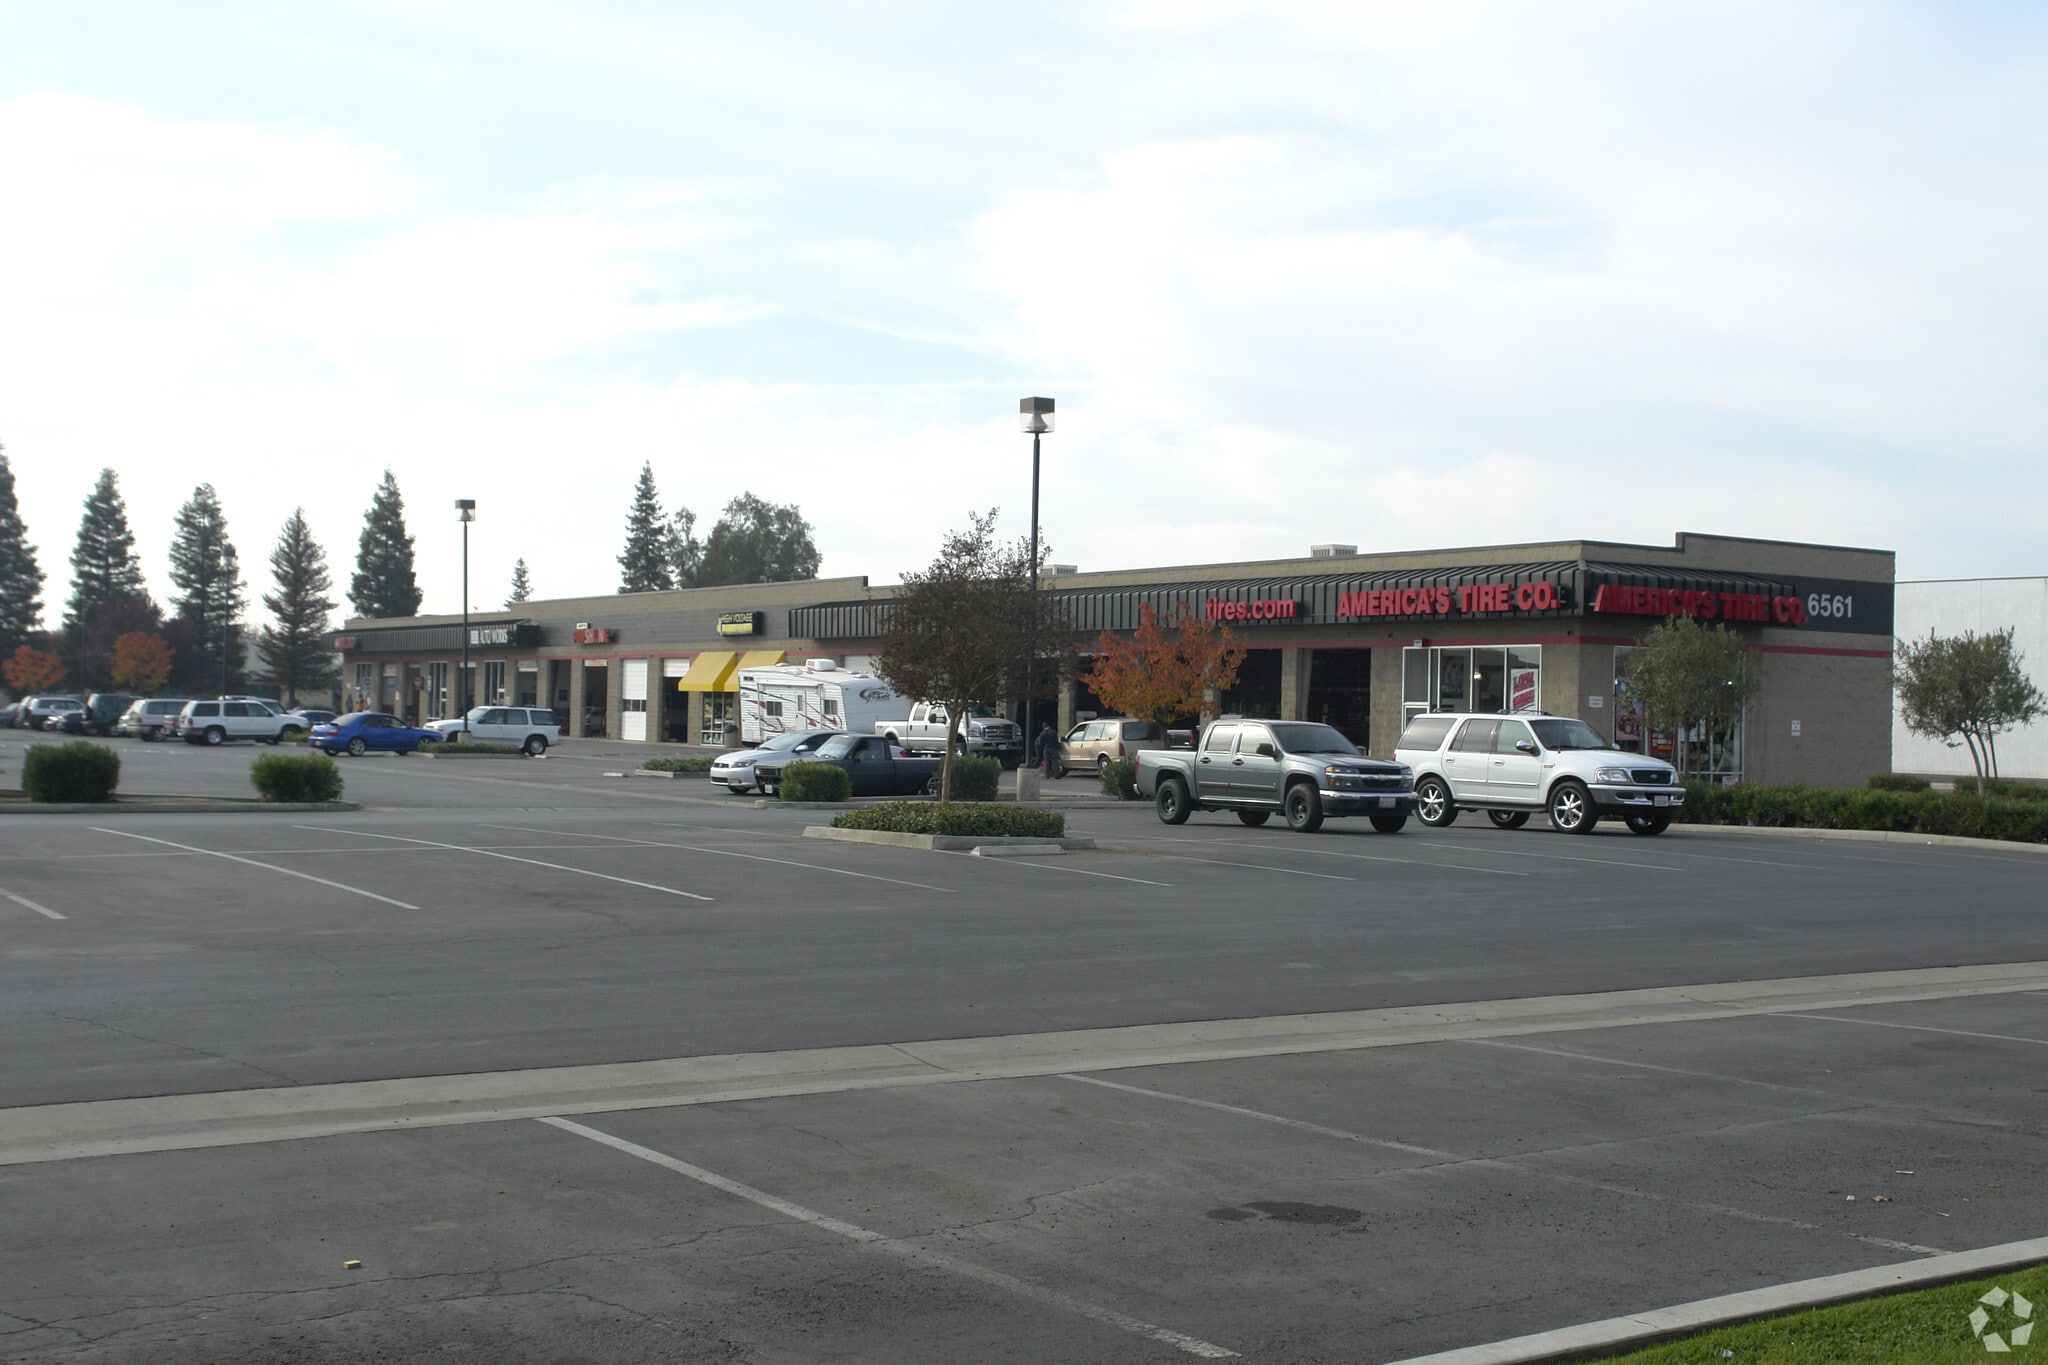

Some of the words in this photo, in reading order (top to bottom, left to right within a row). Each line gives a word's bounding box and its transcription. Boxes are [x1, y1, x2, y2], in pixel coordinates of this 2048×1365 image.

[1205, 596, 1297, 622] tires.com
[1336, 586, 1454, 618] AMERICA'S
[1457, 583, 1513, 613] TIRE
[1516, 580, 1560, 611] CO.
[1593, 584, 1718, 619] AMERICA'S
[1719, 592, 1770, 622] TIRE
[1772, 596, 1809, 624] CO.
[1807, 593, 1853, 618] 6561
[584, 627, 609, 644] SHNE
